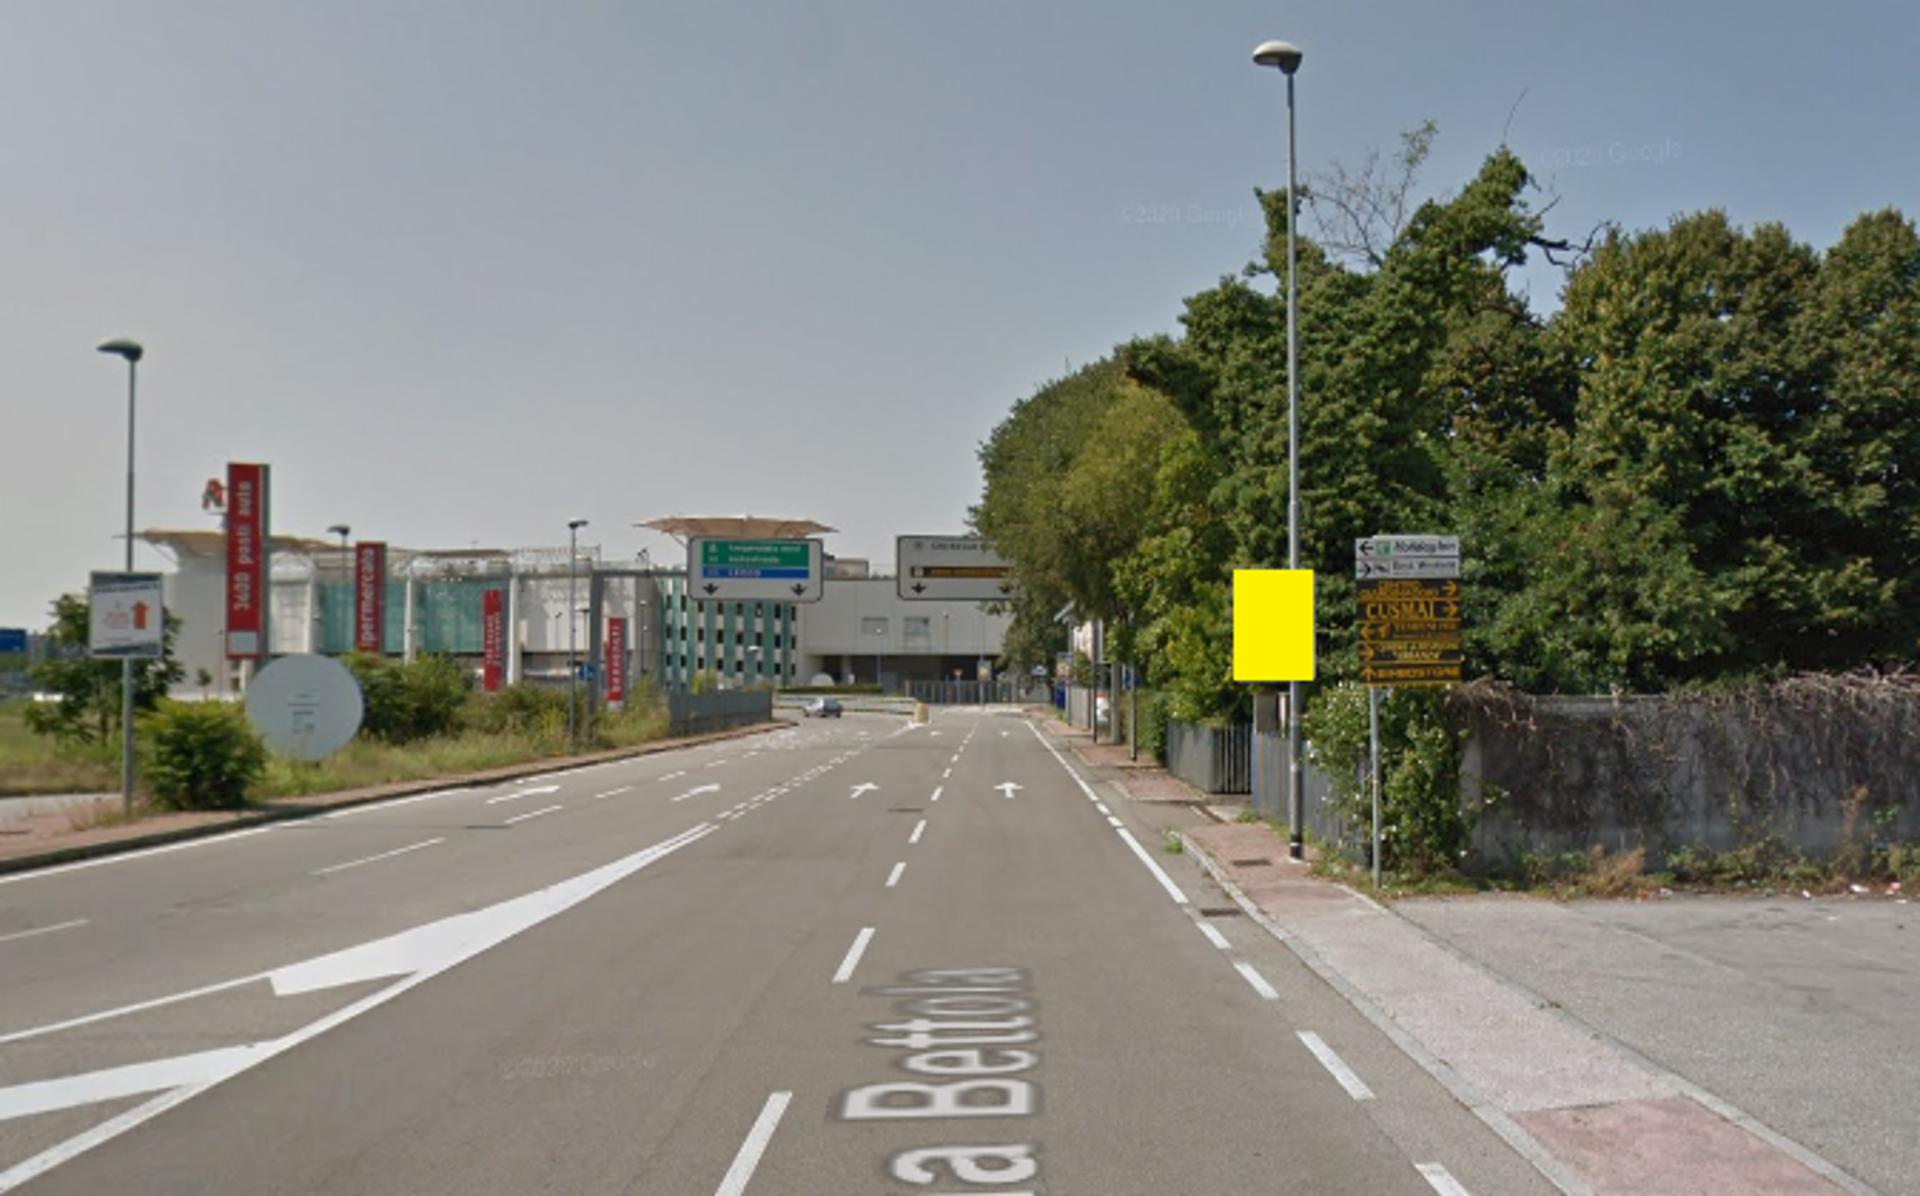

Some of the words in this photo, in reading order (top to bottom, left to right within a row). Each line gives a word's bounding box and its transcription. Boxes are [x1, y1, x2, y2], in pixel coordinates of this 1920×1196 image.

[236, 480, 252, 516] auto
[235, 526, 254, 564] posti
[233, 571, 251, 613] 3600
[359, 547, 377, 648] ipermercato
[843, 966, 1039, 1119] Bettola
